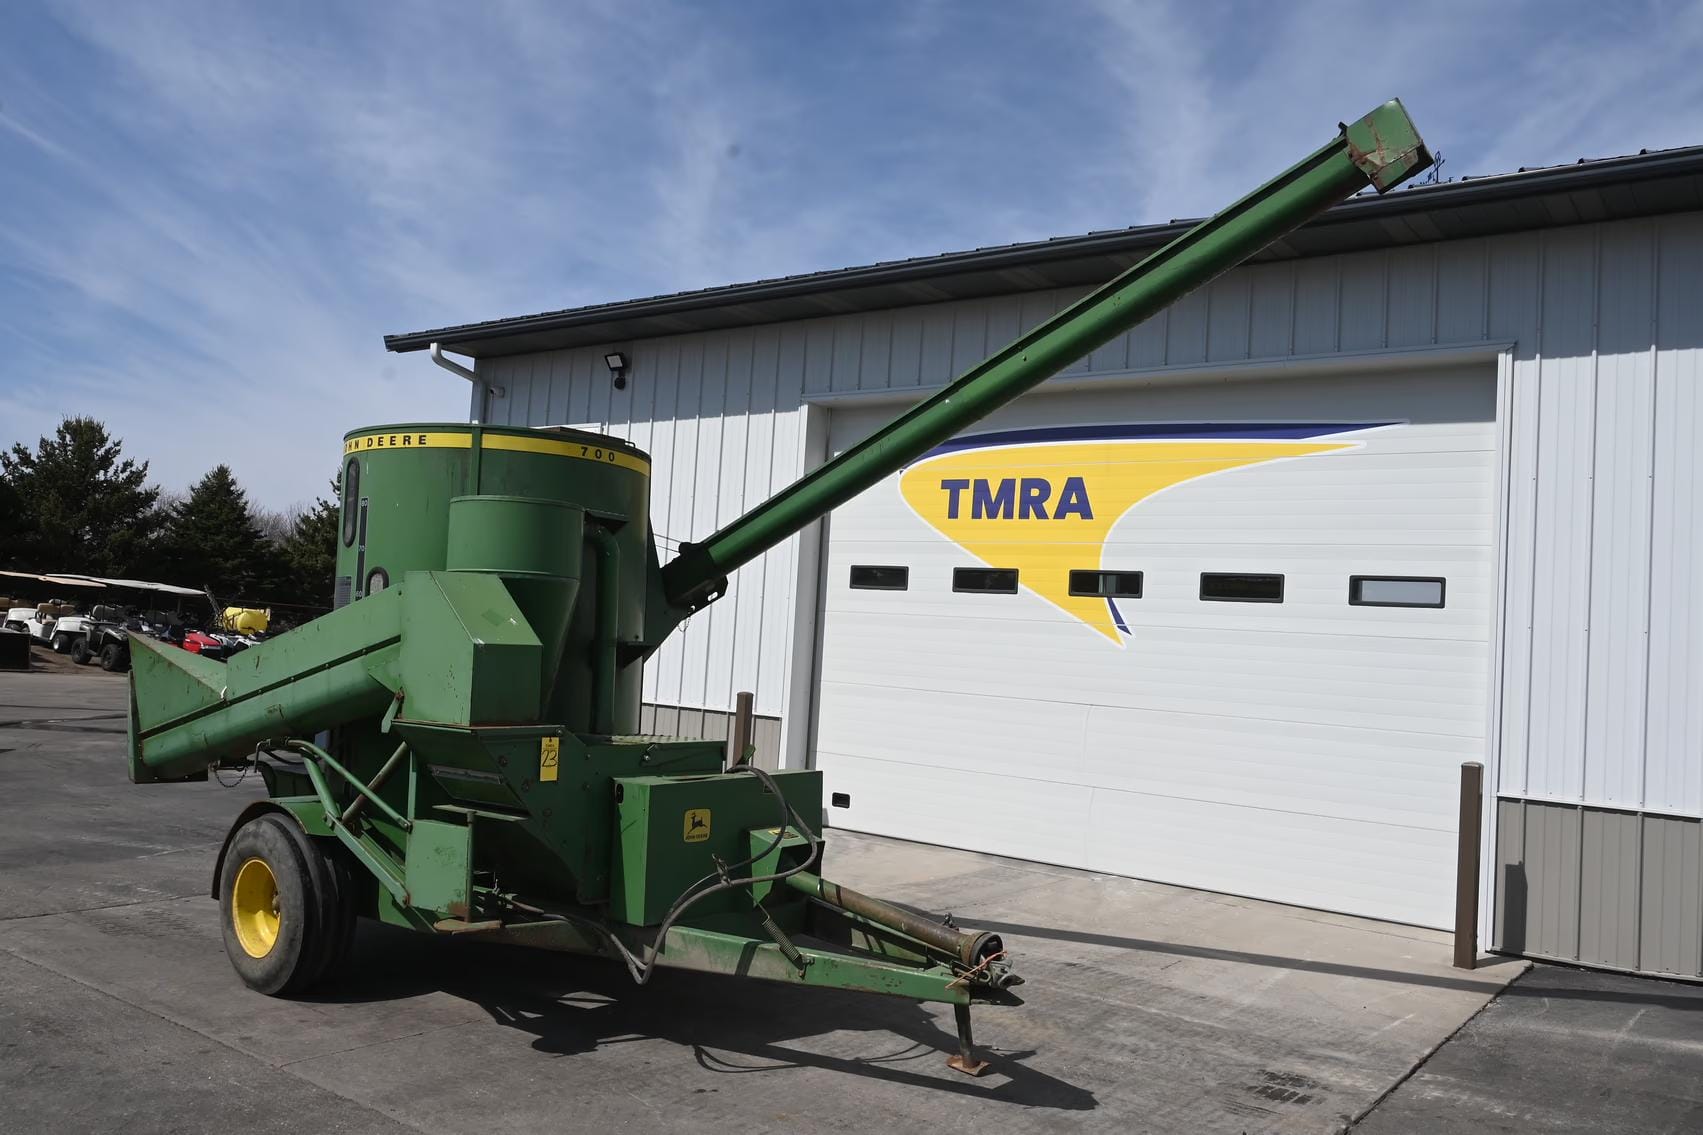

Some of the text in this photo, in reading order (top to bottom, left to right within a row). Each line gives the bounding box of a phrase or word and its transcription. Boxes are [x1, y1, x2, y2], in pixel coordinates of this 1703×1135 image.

[367, 434, 427, 448] DEERE
[580, 446, 615, 462] 700
[941, 477, 1094, 520] TMRA
[542, 750, 558, 767] 23
